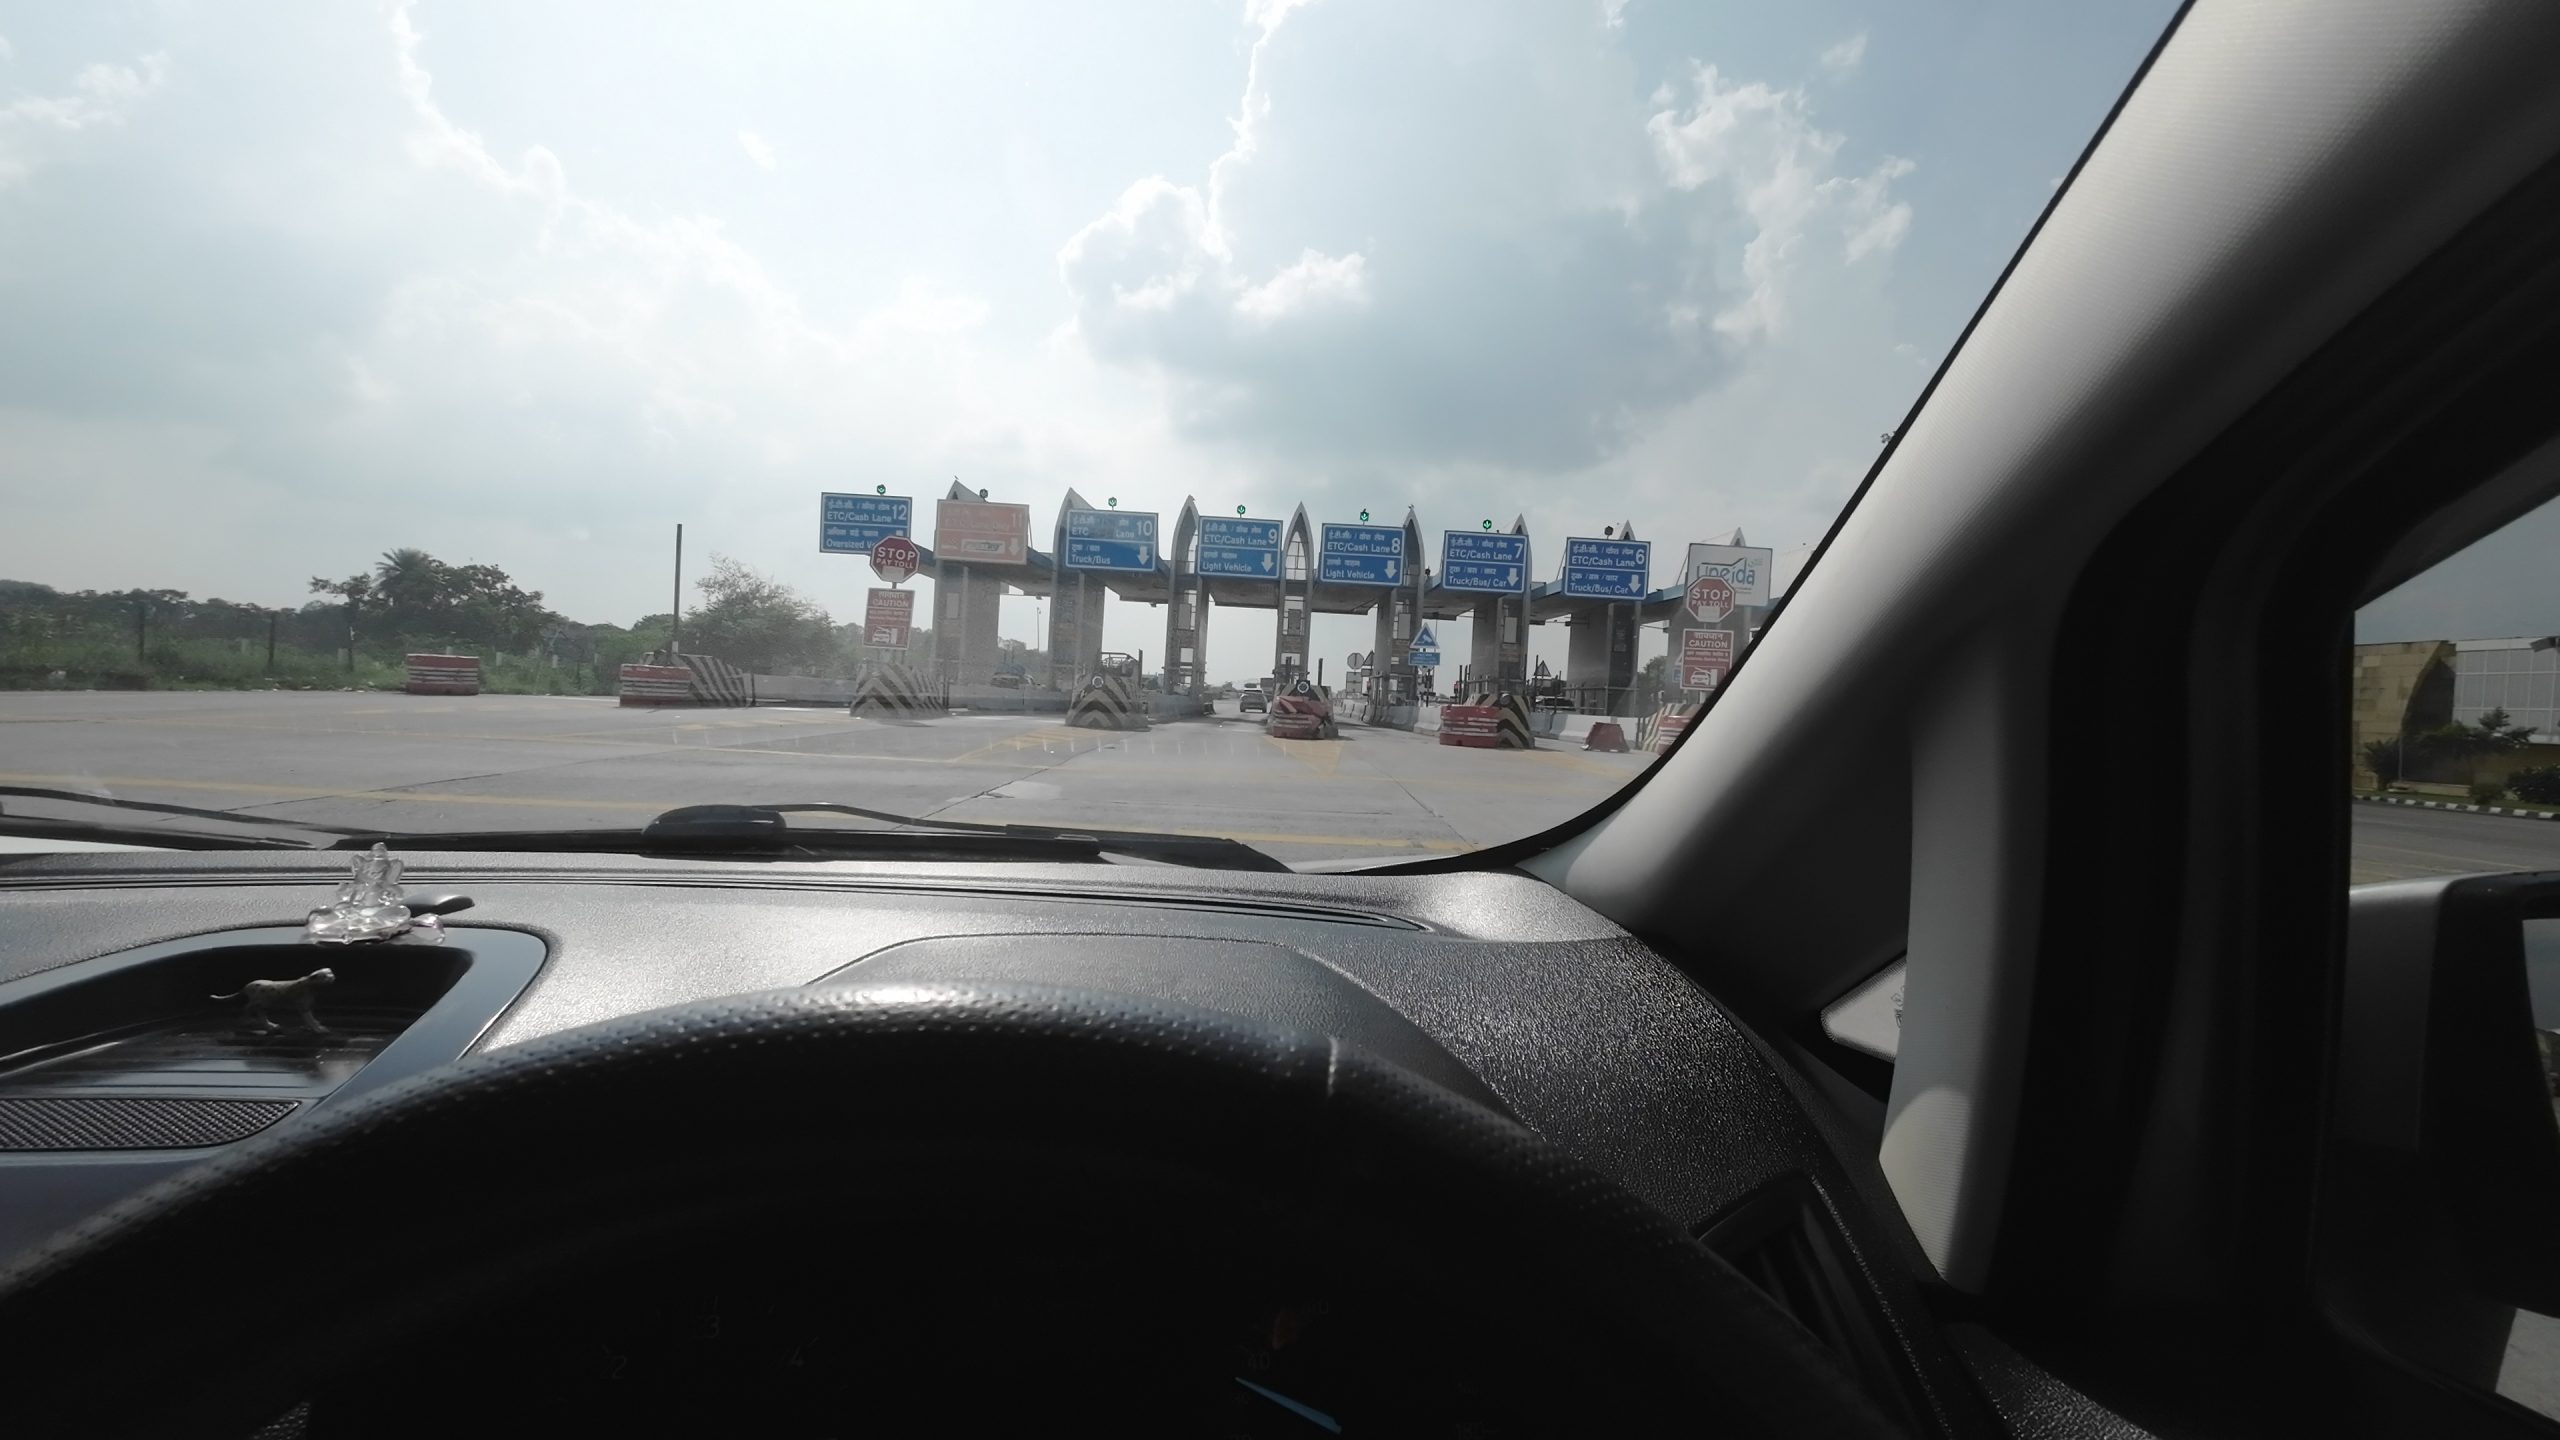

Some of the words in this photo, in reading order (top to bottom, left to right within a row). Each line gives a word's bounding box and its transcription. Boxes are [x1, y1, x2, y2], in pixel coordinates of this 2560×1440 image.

[827, 511, 869, 521] ETC/Cash
[872, 513, 892, 523] Lane
[891, 504, 907, 520] 12
[1071, 527, 1089, 536] ETC
[1116, 529, 1135, 538] Lane
[1136, 519, 1153, 537] 10
[1204, 534, 1245, 545] ETC/Cash
[1247, 537, 1267, 546] Lane
[1268, 528, 1278, 544] 9
[1327, 541, 1368, 552] ETC/Cash
[1371, 543, 1390, 553] Lane
[1391, 537, 1400, 553] 8
[878, 547, 916, 560] STOP
[1449, 548, 1491, 559] ETC/Cash
[1493, 551, 1512, 561] Lane
[1514, 543, 1523, 559] 7
[1571, 555, 1613, 566] ETC/Cash
[1615, 558, 1636, 567] Lane
[1635, 548, 1645, 565] 6
[876, 558, 893, 566] PAY
[895, 559, 914, 569] TOLL
[1071, 554, 1111, 565] Truck/Bus
[1224, 562, 1252, 572] Vehicle
[1325, 568, 1345, 579] Light
[1347, 569, 1375, 579] Vehicle
[1493, 578, 1507, 587] Car
[1614, 585, 1629, 595] Car
[1692, 587, 1730, 600] STOP
[1710, 601, 1728, 609] TOLL
[1688, 639, 1728, 648] CAUTION
